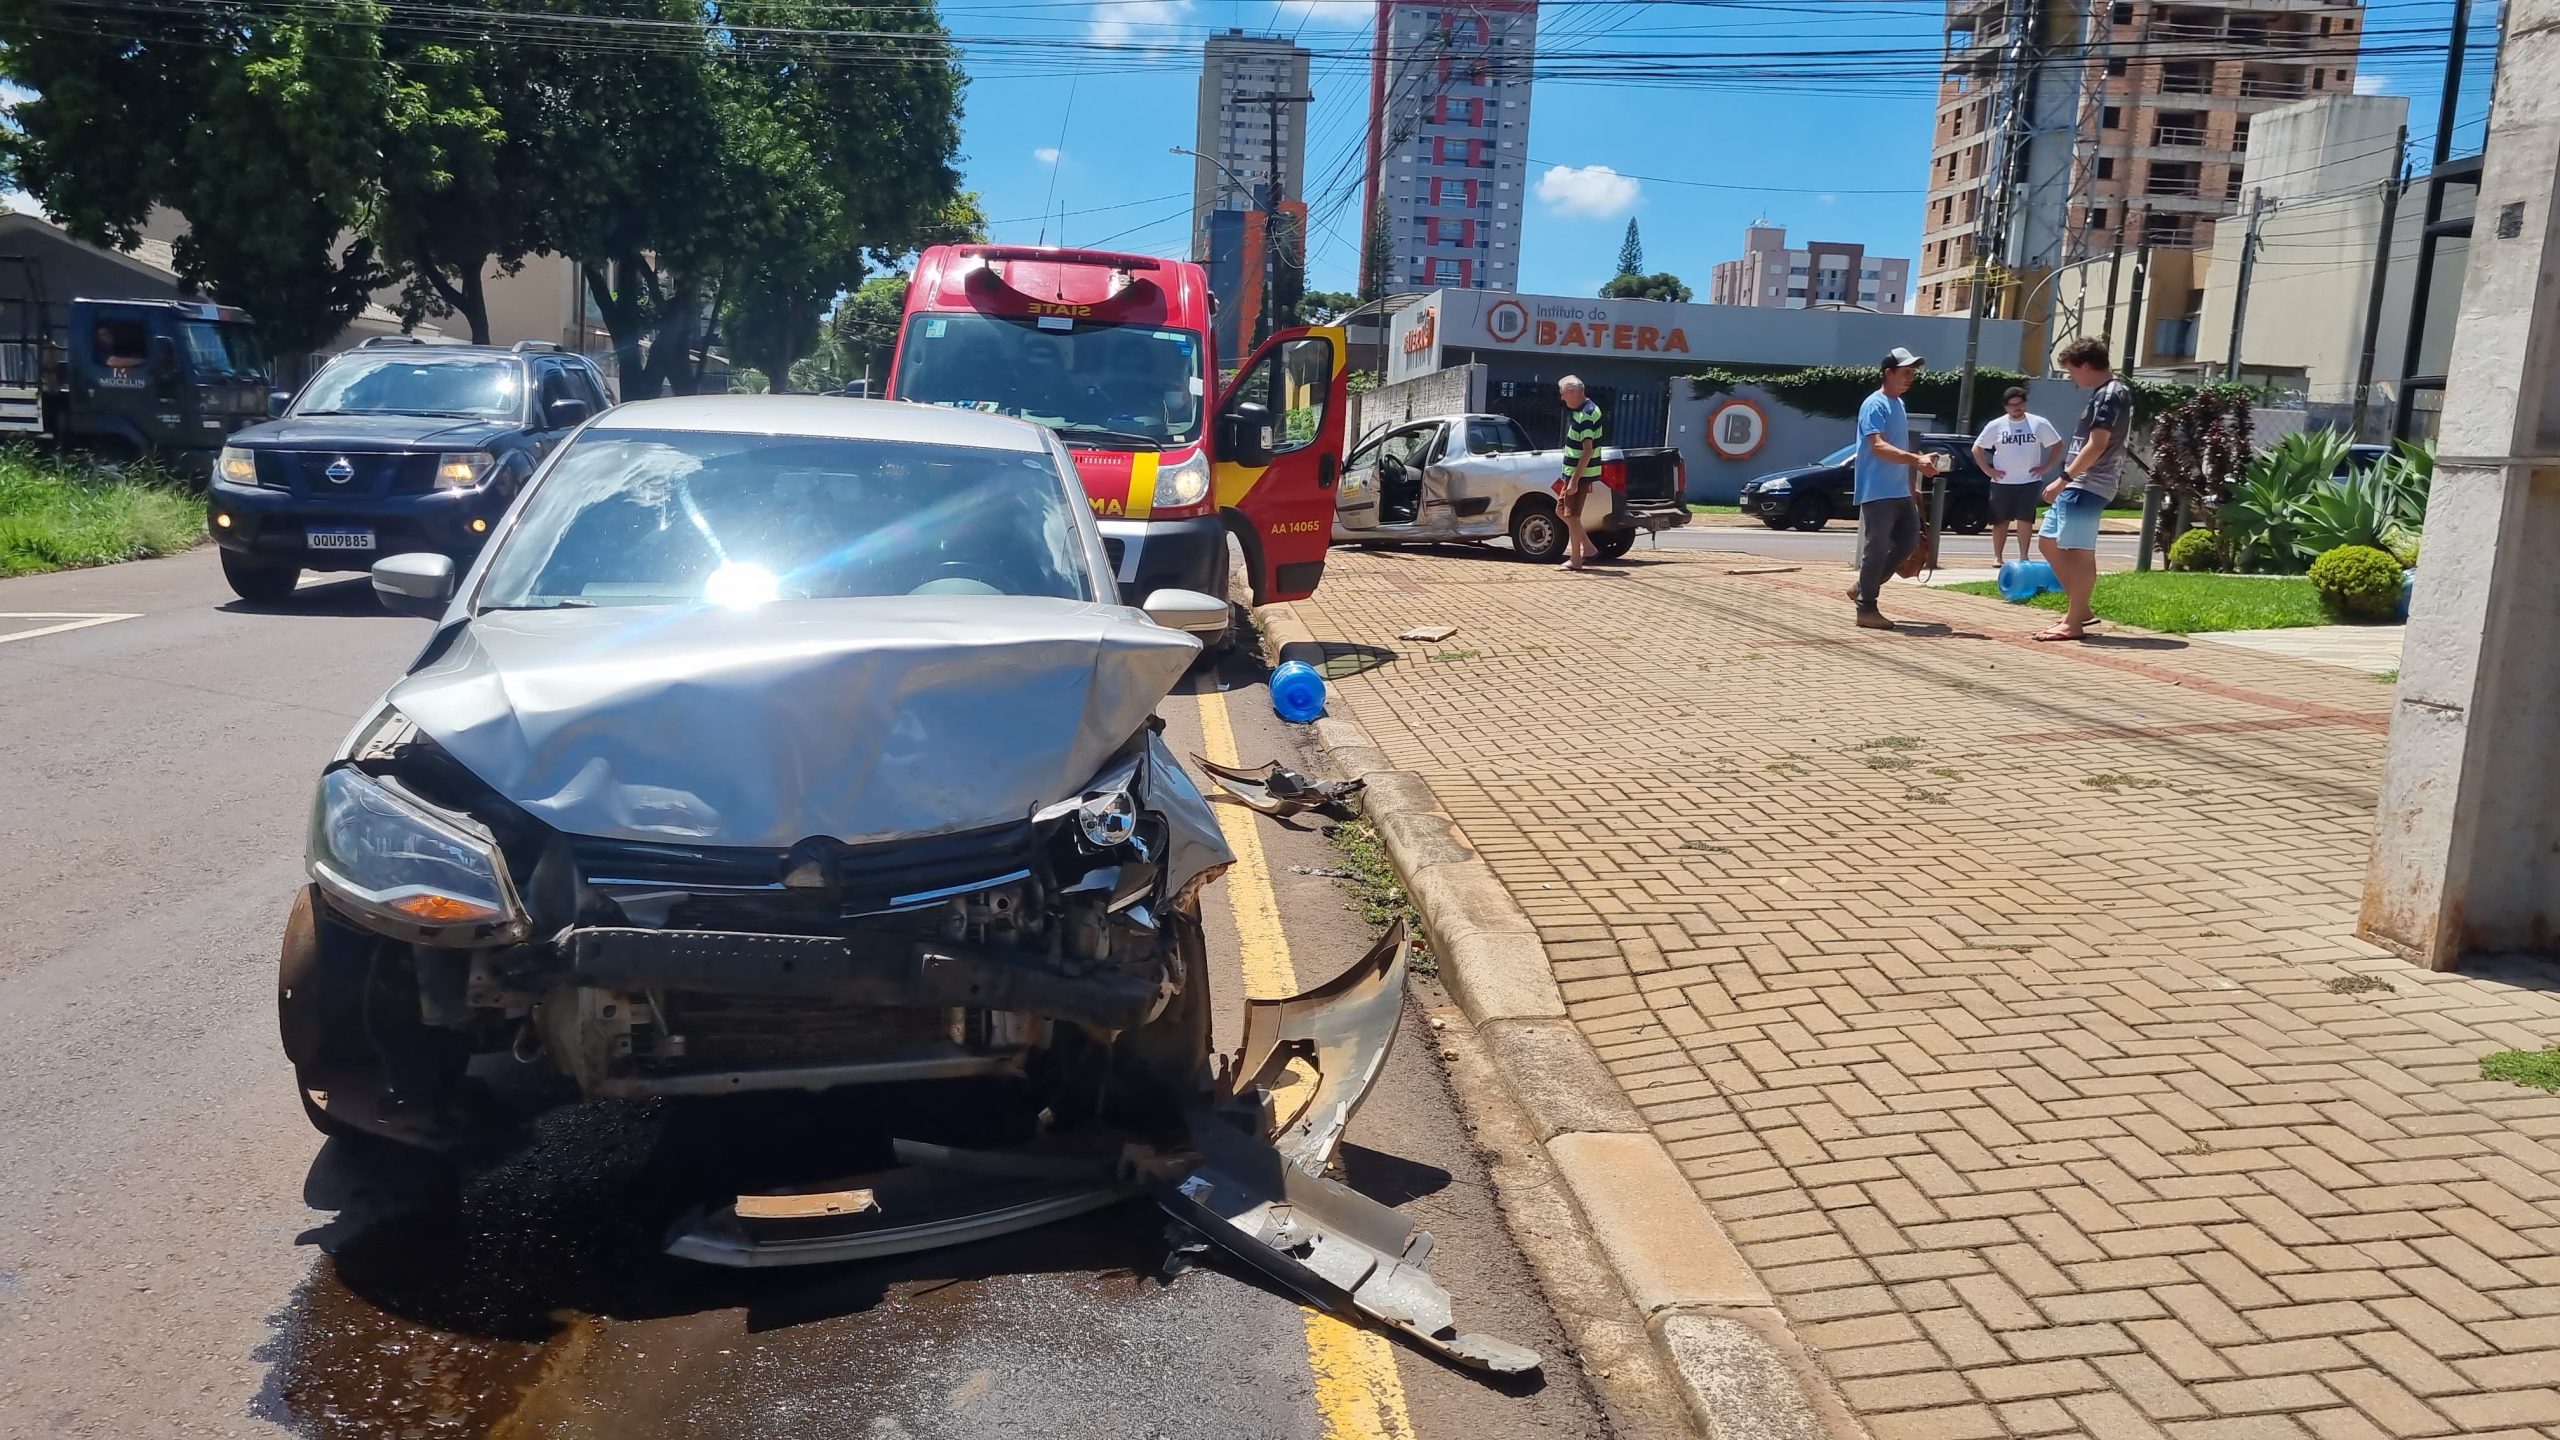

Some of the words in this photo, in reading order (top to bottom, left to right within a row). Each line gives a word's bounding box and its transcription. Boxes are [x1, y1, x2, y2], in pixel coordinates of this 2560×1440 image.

[1536, 304, 1585, 320] Instituto
[1588, 306, 1607, 320] do
[2001, 431, 2037, 446] BEATLES
[1271, 523, 1287, 535] AA
[1289, 520, 1320, 533] 14065
